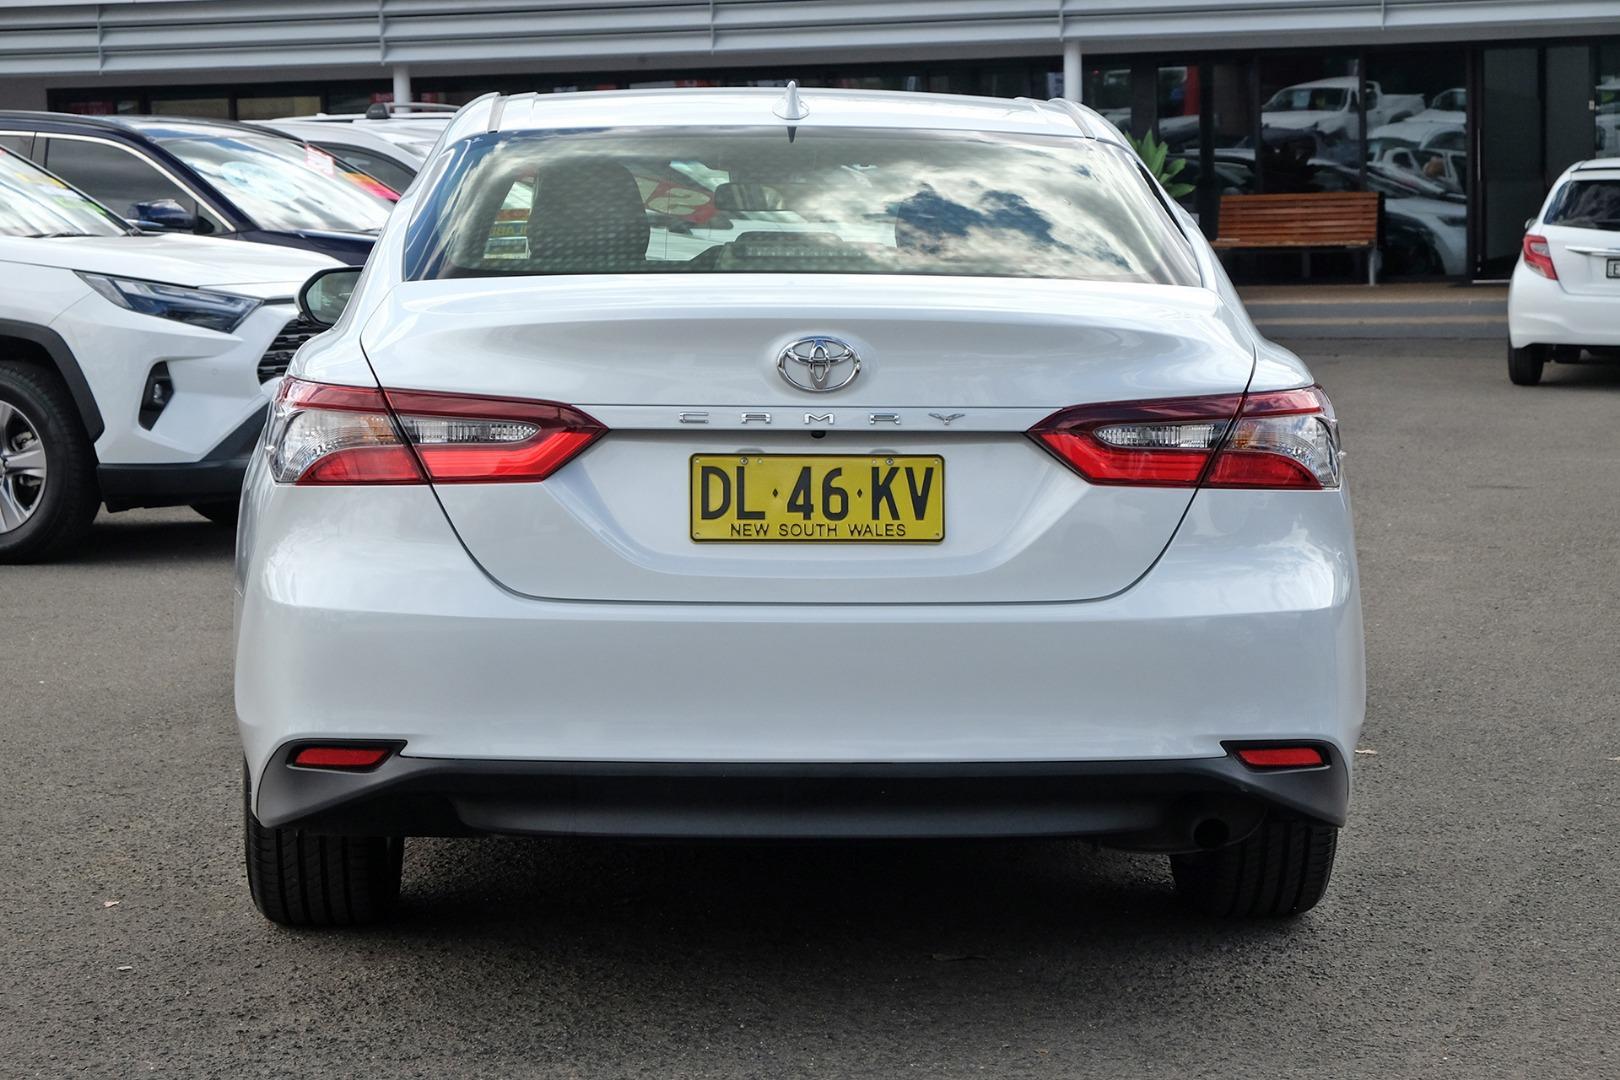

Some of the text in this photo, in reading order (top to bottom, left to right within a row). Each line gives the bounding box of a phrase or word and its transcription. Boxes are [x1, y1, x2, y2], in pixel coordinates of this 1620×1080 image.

[679, 411, 966, 426] CAMRY
[730, 523, 906, 538] NEW SOUTH WALES
